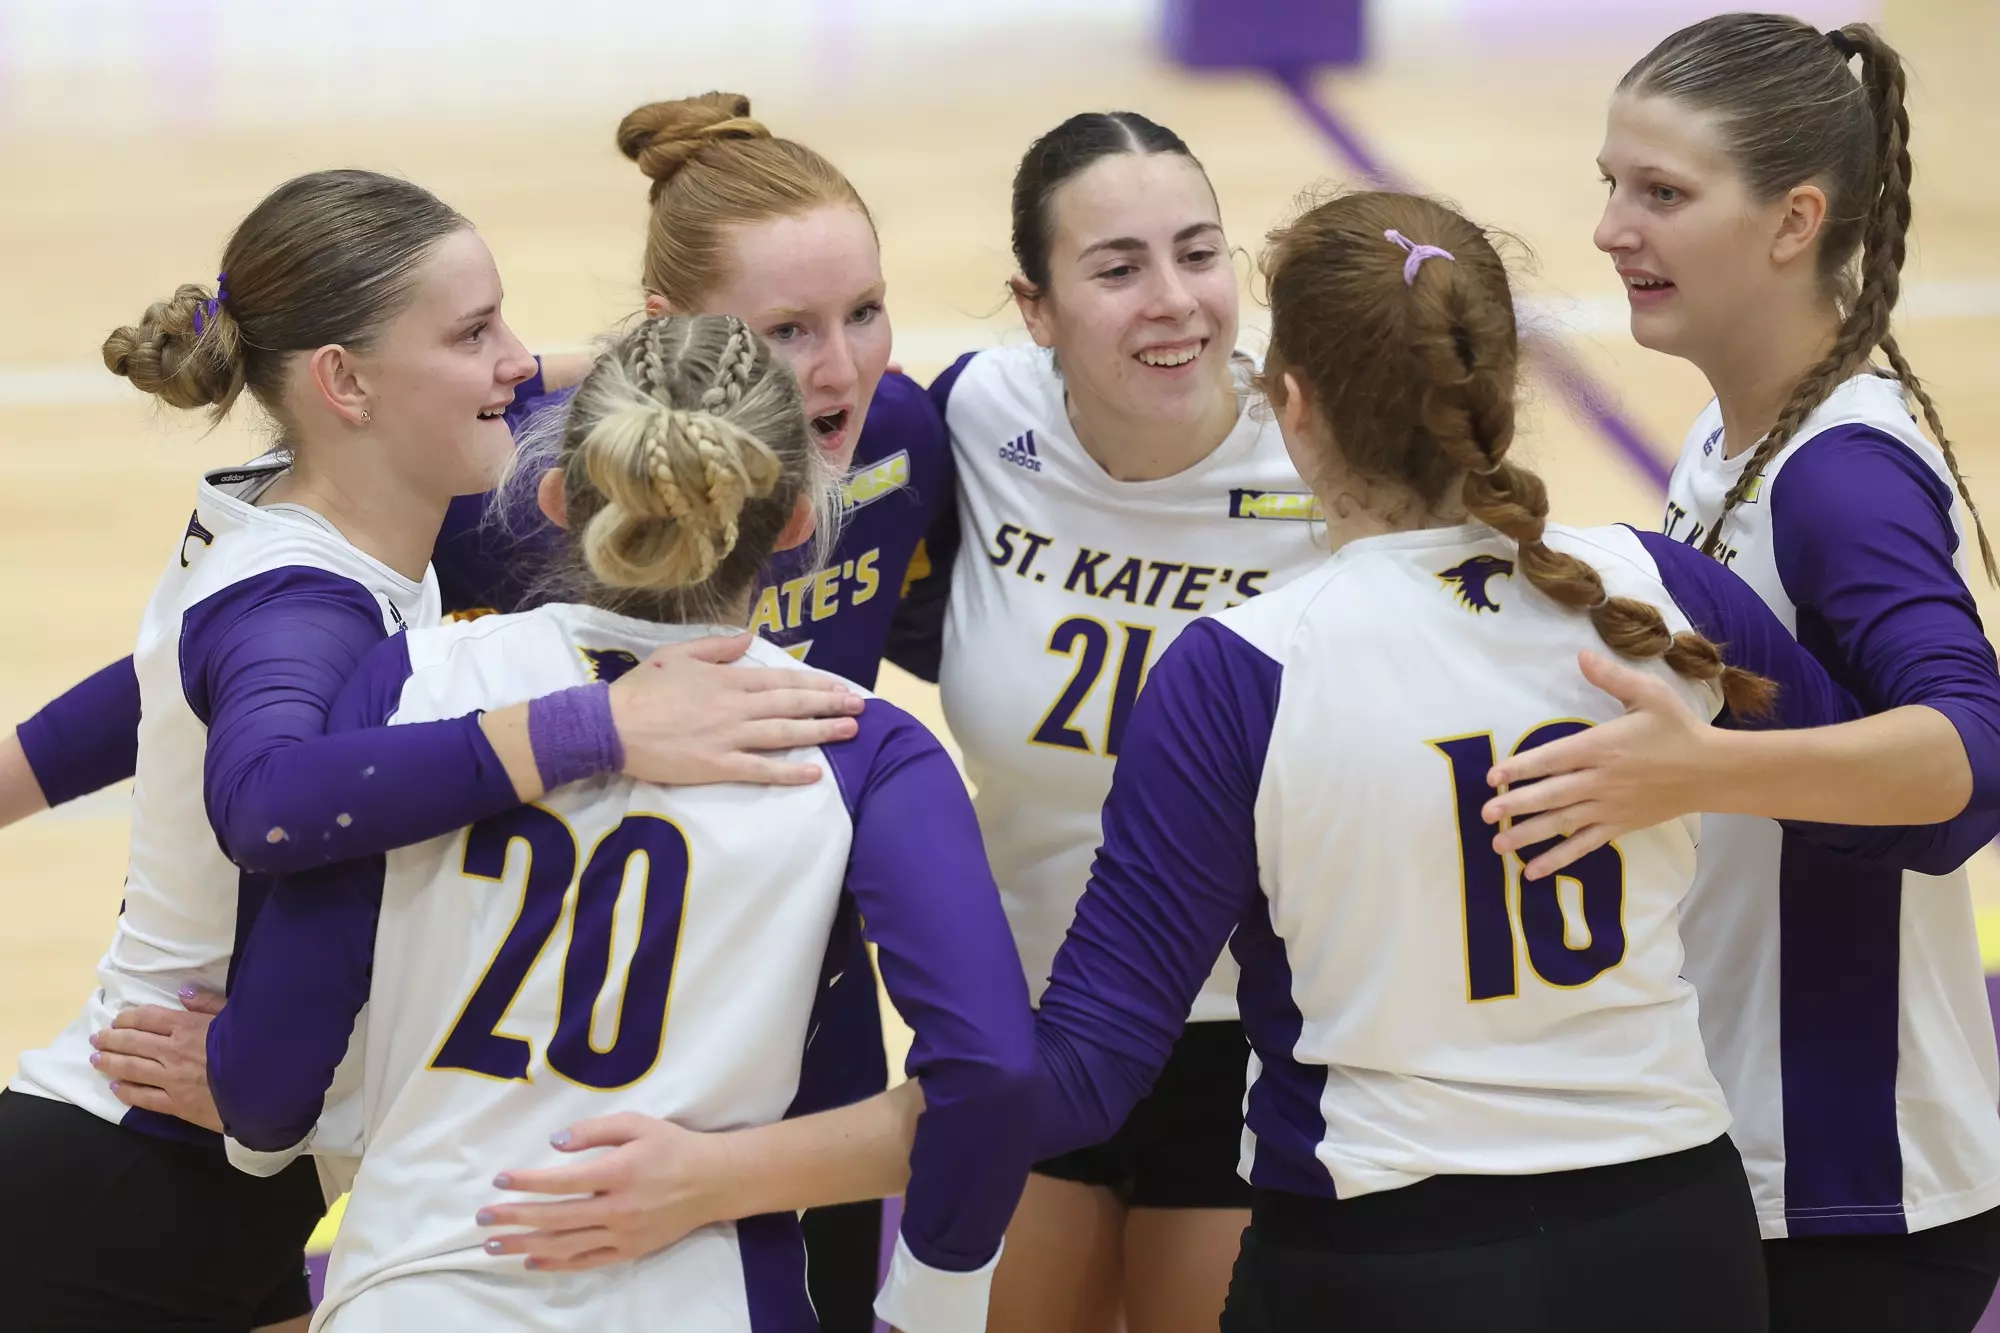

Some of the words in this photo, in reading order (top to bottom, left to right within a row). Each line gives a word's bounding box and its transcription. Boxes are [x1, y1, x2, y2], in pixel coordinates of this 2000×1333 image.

[999, 447, 1042, 472] adidas
[749, 548, 880, 637] ATE'S
[989, 523, 1055, 582] ST.
[1062, 546, 1270, 612] KATE'S
[1027, 614, 1157, 759] 21
[425, 801, 693, 1092] 20
